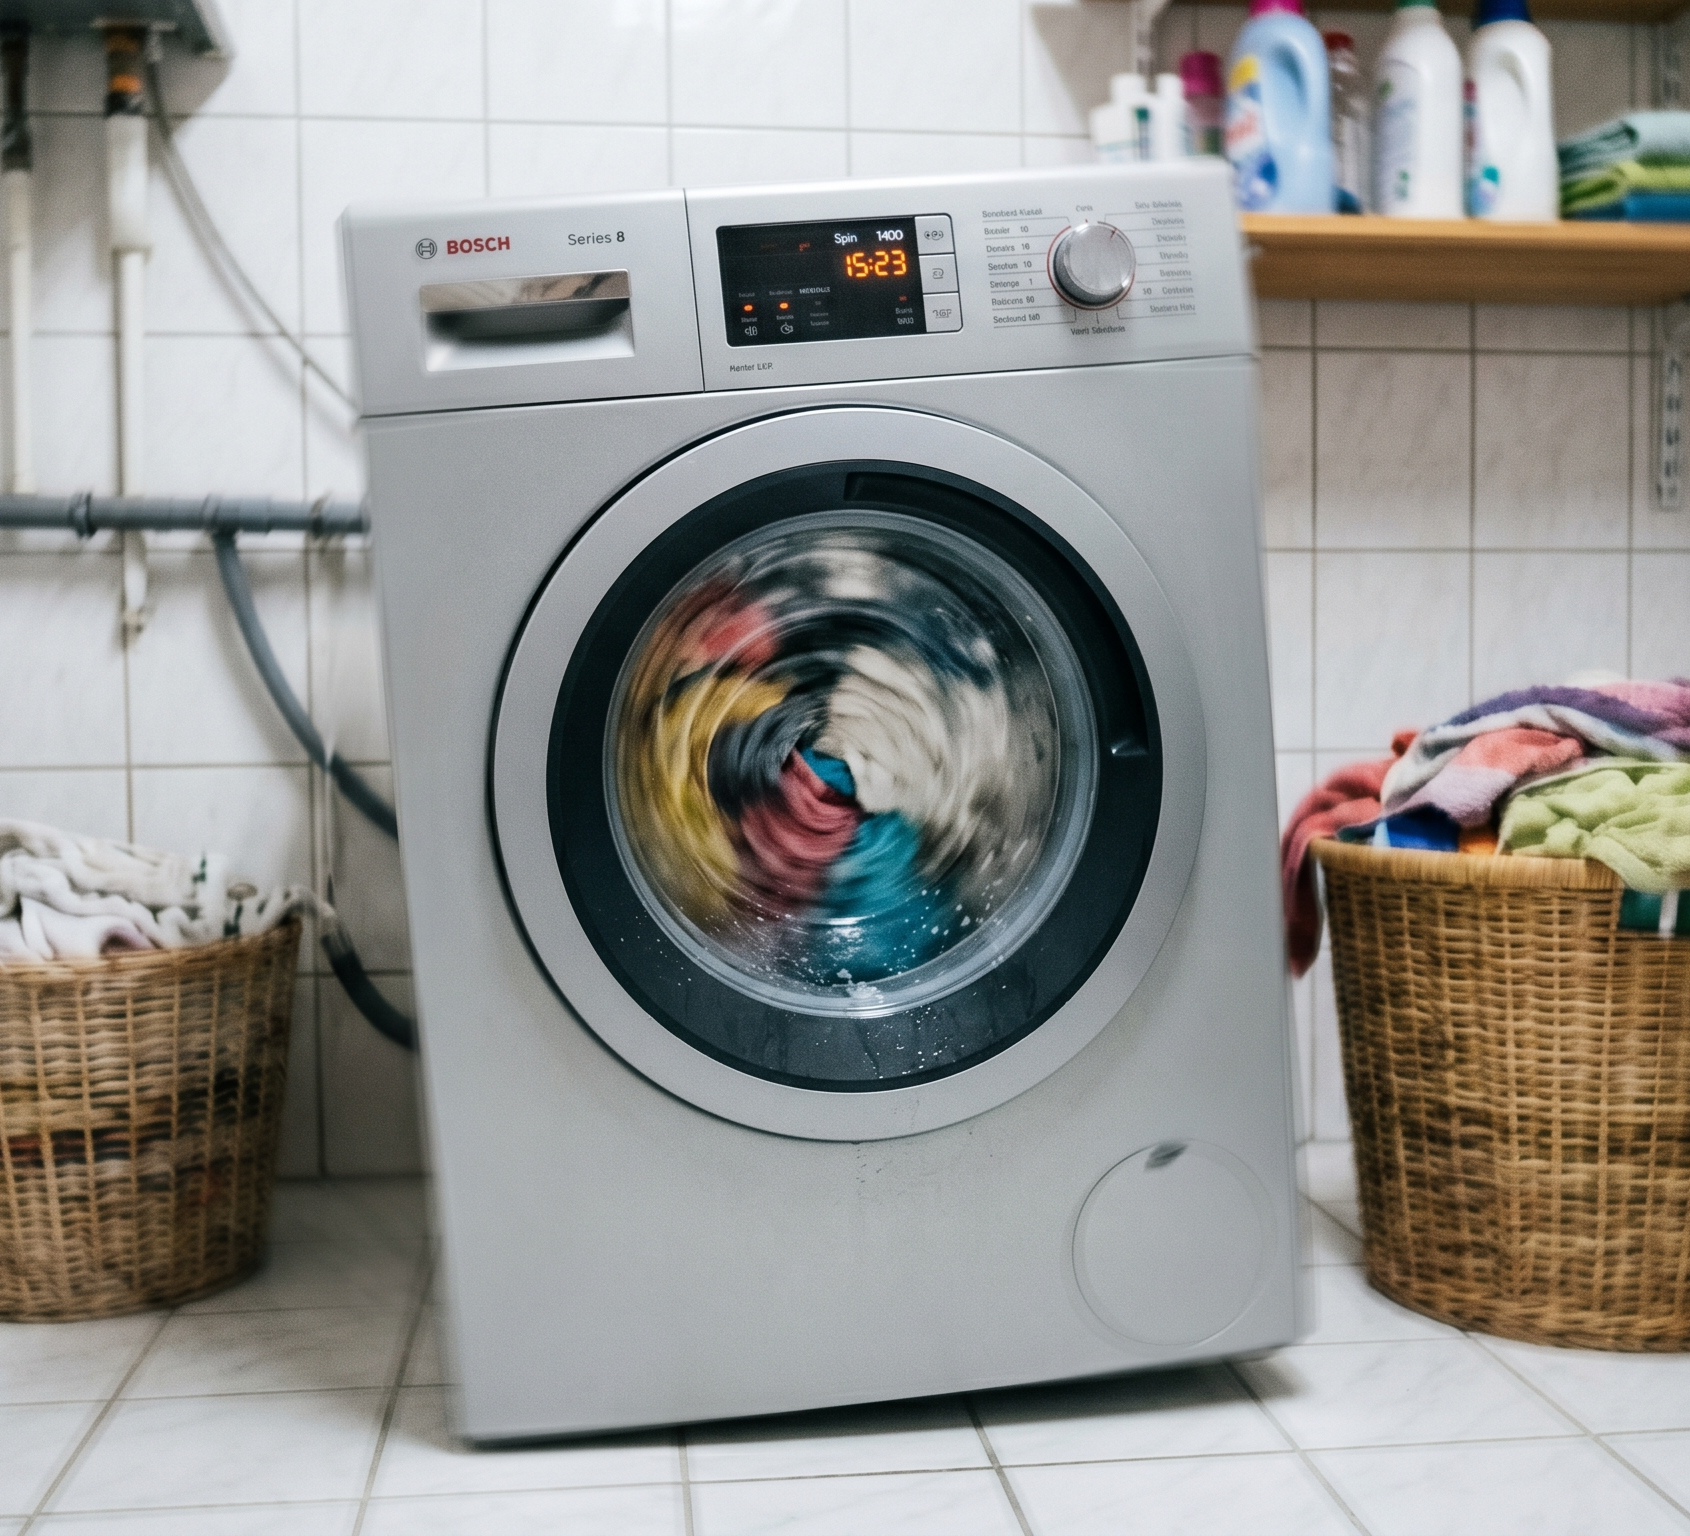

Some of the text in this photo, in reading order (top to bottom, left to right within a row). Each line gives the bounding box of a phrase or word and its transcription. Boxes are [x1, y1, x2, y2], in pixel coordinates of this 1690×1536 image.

[446, 236, 511, 255] BOSCH
[568, 231, 625, 246] Series 8
[834, 229, 903, 246] Spin 1400
[845, 249, 908, 279] 15:23
